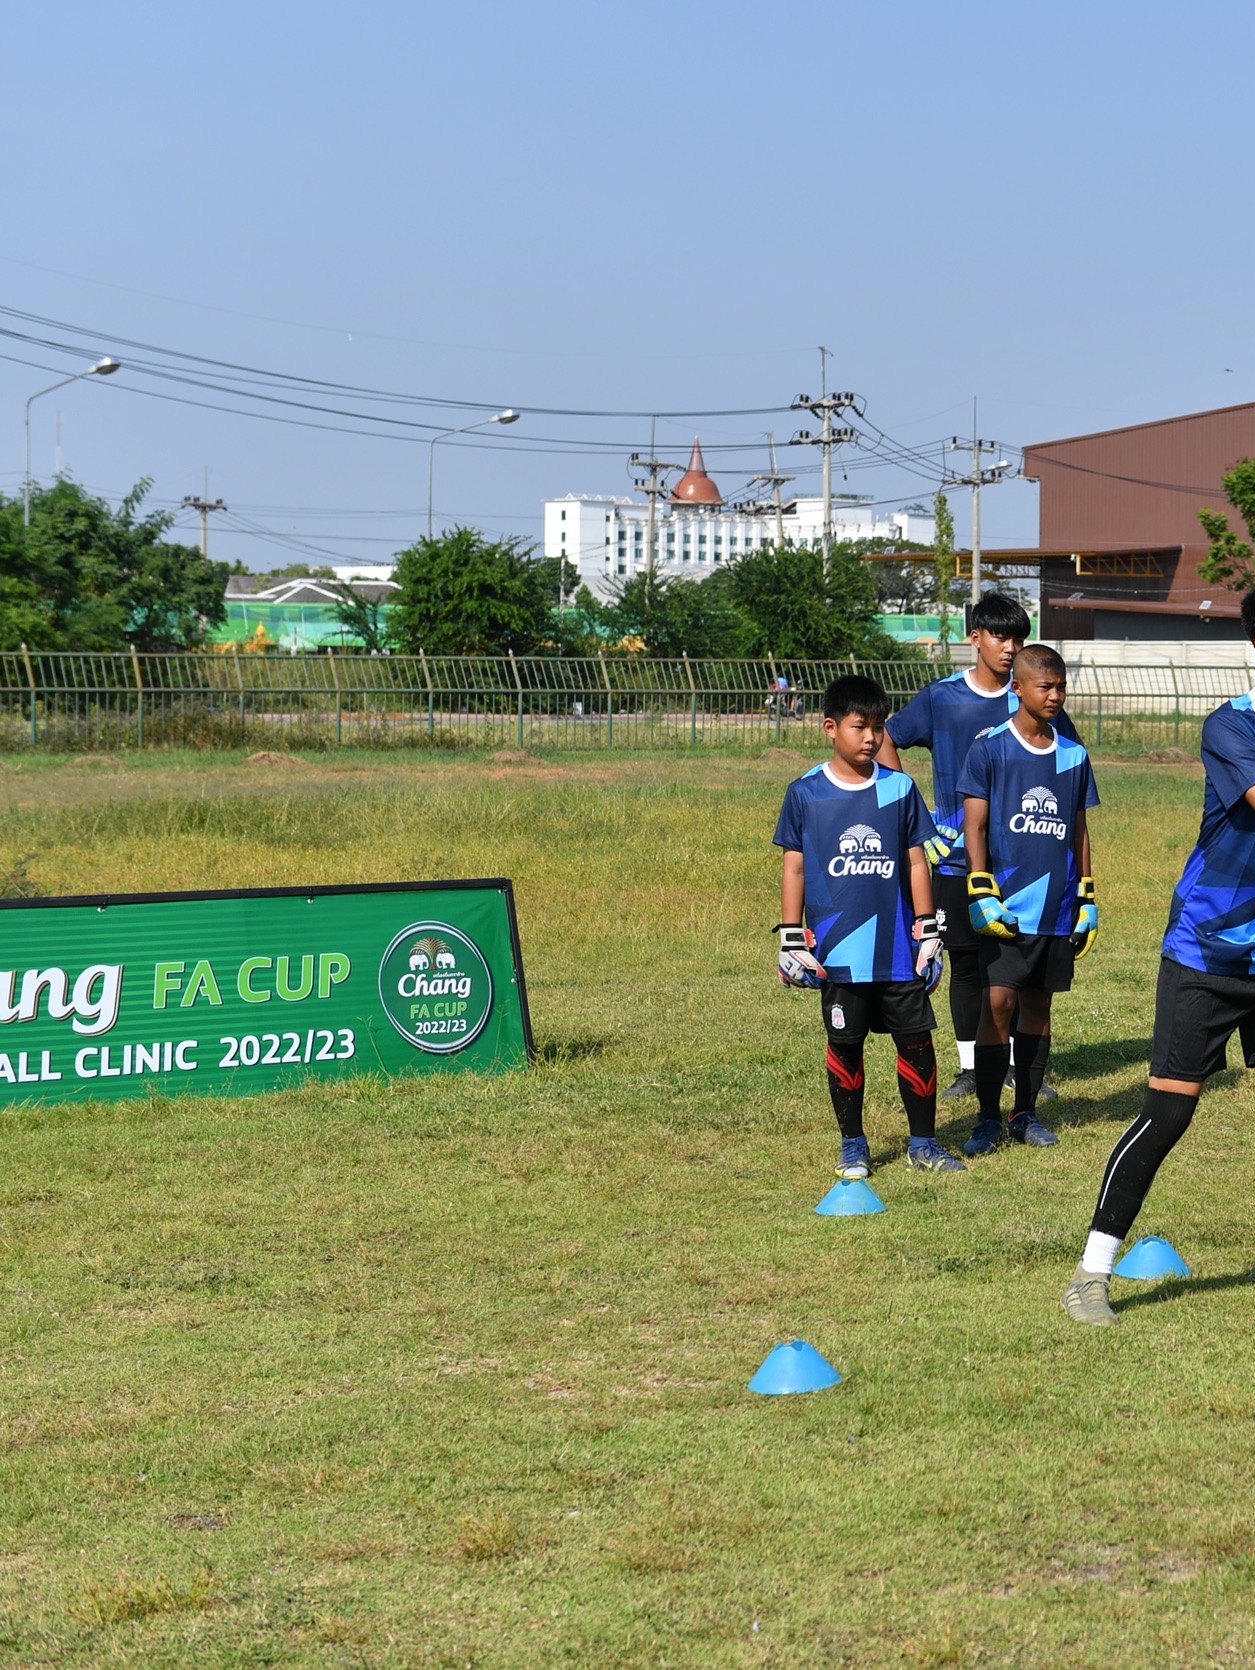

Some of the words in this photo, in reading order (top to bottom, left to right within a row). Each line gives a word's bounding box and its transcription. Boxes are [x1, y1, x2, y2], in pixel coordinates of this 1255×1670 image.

[1009, 813, 1067, 840] Chang
[828, 855, 895, 879] Chang
[153, 960, 223, 1009] FA
[237, 953, 351, 1003] CUP
[398, 973, 471, 998] Chang
[410, 1003, 430, 1019] FA
[433, 1001, 467, 1017] CUP
[415, 1019, 467, 1035] 2022/23
[75, 1040, 198, 1078] CLINIC
[219, 1028, 355, 1068] 2022/23
